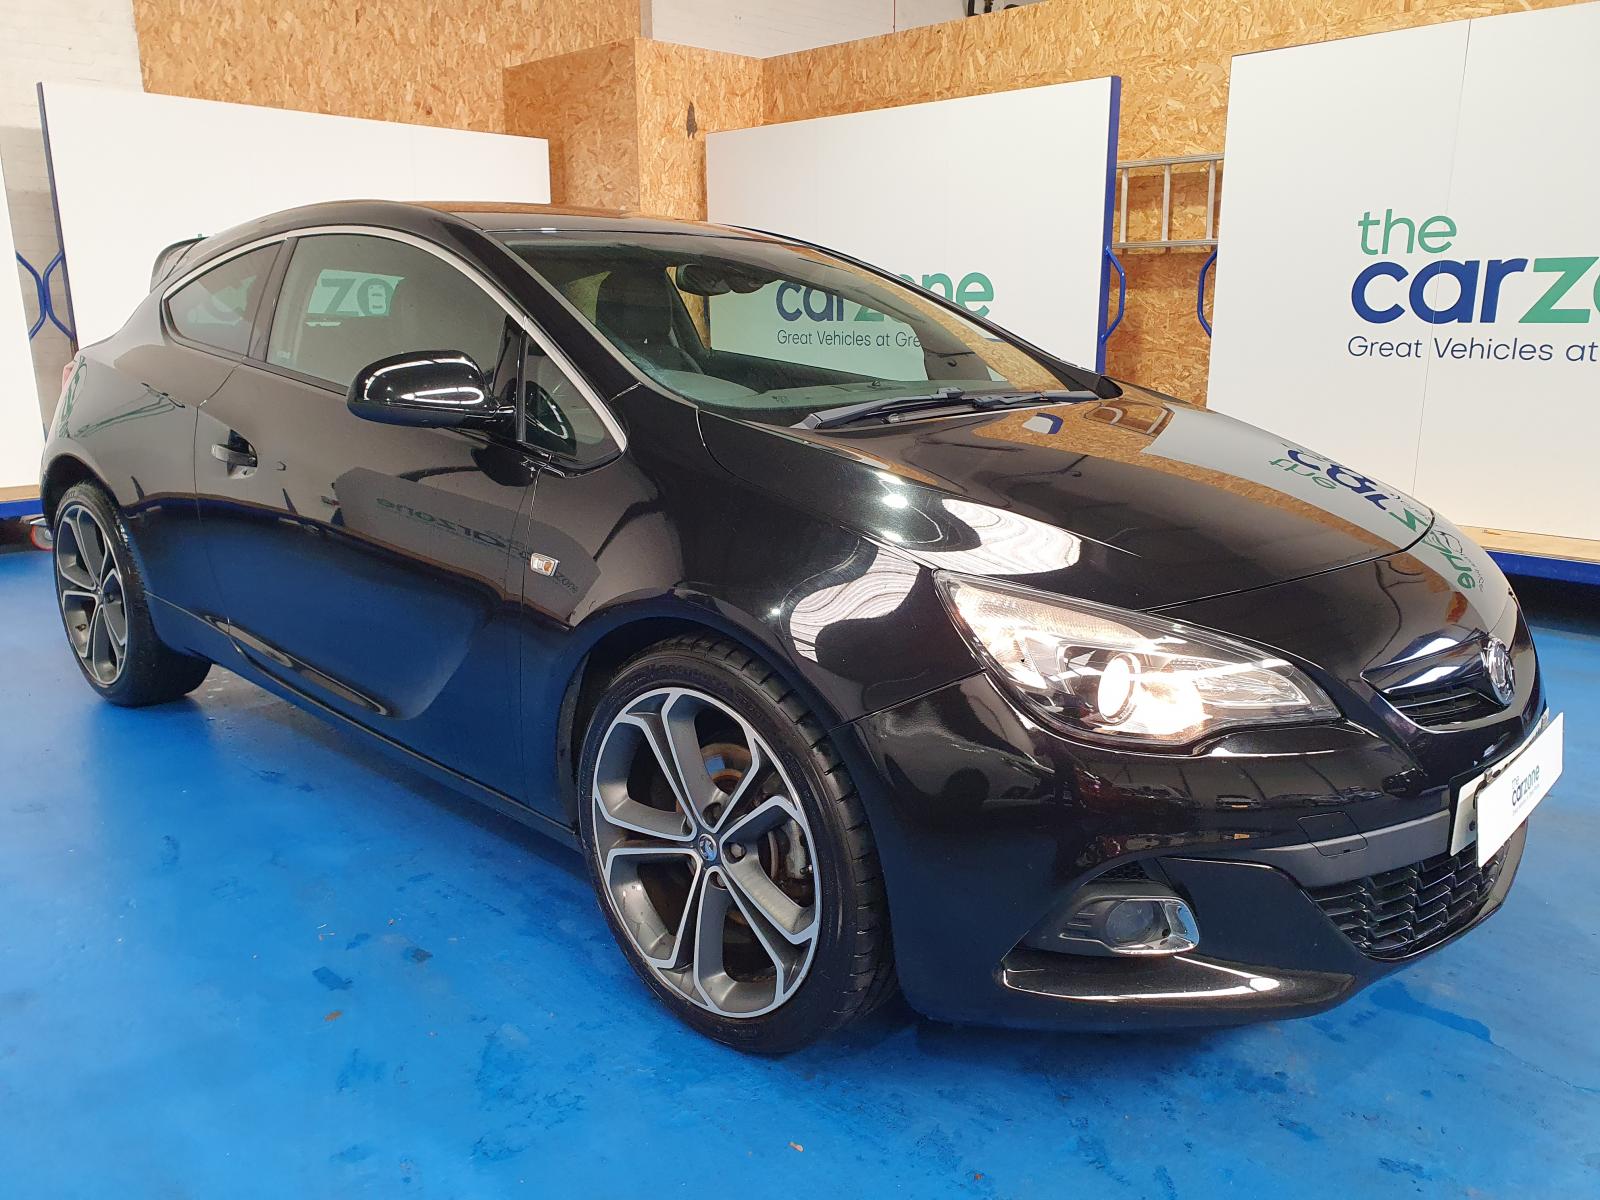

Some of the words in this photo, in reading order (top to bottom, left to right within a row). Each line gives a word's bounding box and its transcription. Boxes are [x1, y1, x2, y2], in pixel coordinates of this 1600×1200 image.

[1357, 208, 1457, 256] the
[1351, 256, 1600, 325] carz
[777, 329, 813, 345] Great
[817, 330, 871, 347] Vehicles
[876, 334, 890, 347] at
[1347, 335, 1423, 359] Great
[1434, 337, 1553, 362] Vehicles
[1565, 342, 1599, 363] at
[1511, 764, 1540, 806] carzone
